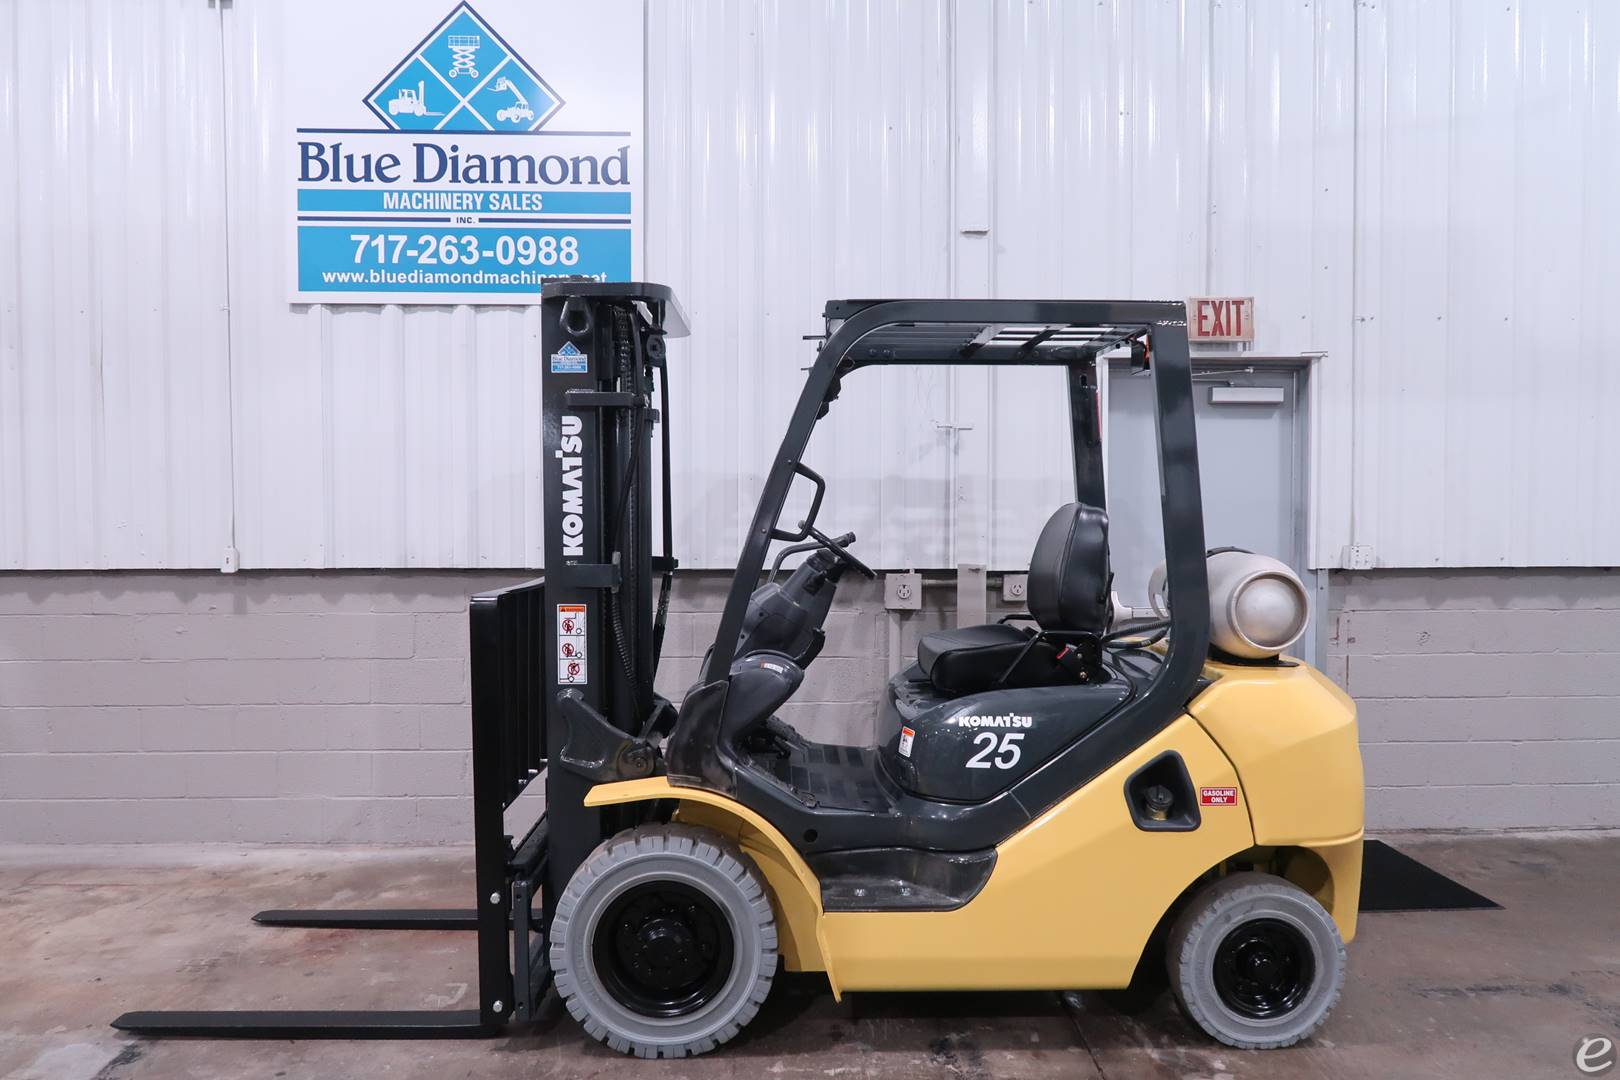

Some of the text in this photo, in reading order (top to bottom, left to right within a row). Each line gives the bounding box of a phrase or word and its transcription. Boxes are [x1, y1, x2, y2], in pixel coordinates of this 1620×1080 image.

[298, 141, 631, 186] Blue Diamond
[383, 192, 543, 211] MACHINERY SALES
[456, 216, 476, 224] INC.
[350, 234, 579, 266] 717-263-0988
[1197, 300, 1244, 336] EXIT
[555, 415, 583, 556] KOMATSU
[958, 712, 1032, 728] KOMATSU
[965, 731, 1025, 769] 25
